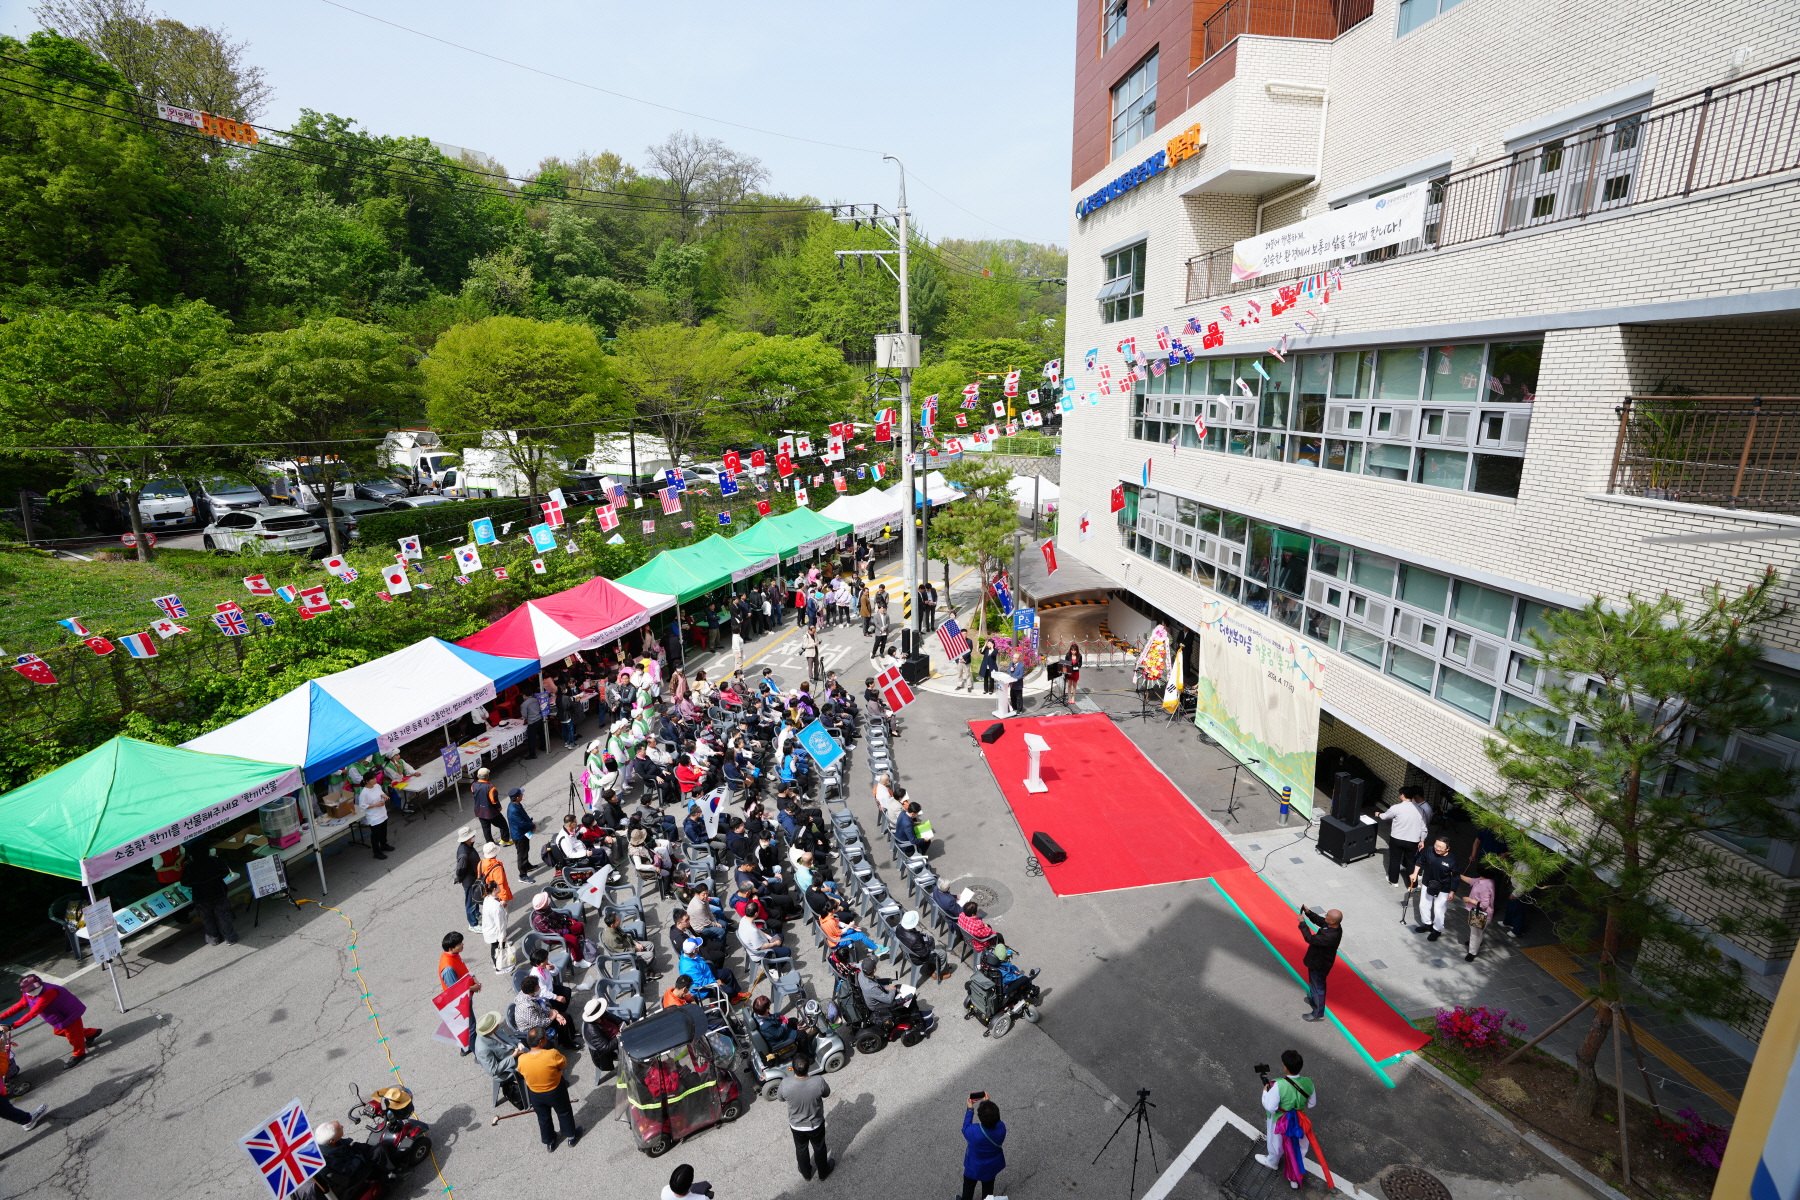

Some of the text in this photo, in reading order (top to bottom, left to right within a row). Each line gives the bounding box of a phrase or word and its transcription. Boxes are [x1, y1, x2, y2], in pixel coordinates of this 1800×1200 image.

[1284, 247, 1311, 262] 환경에서
[1311, 239, 1331, 255] 보통의
[1332, 235, 1346, 252] 삶을
[1348, 231, 1368, 247] 함께
[1018, 615, 1025, 625] P
[114, 839, 146, 861] 소중한
[149, 823, 181, 846] 한끼를
[184, 799, 240, 831] 선물해주세요
